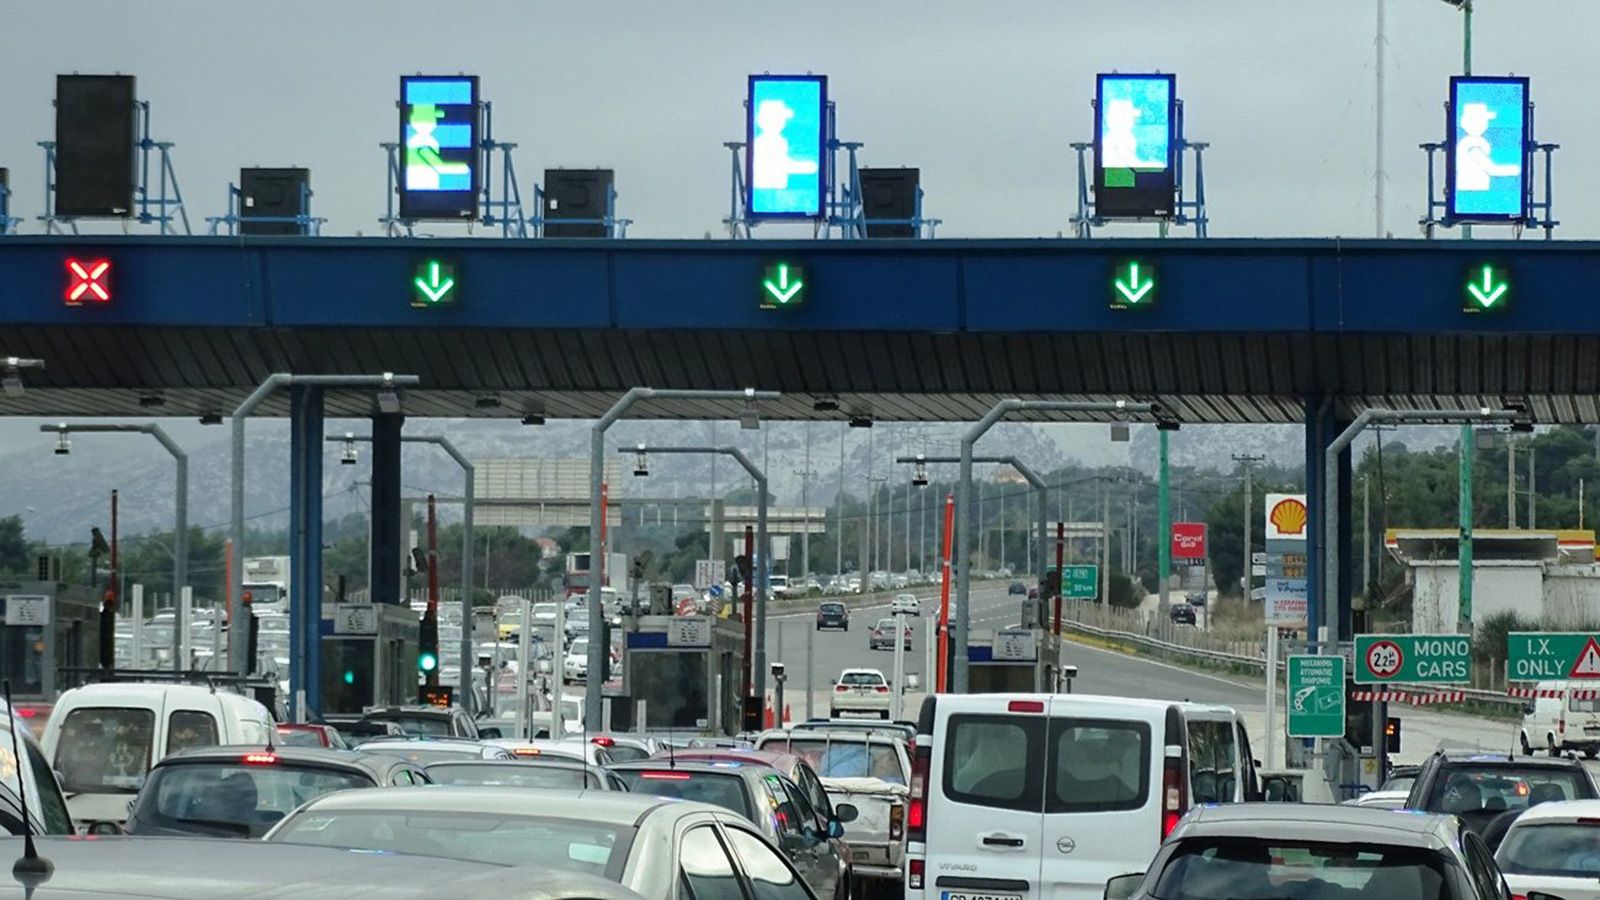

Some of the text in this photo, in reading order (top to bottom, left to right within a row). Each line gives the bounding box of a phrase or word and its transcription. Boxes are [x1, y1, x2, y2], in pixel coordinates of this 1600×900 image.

[1174, 533, 1203, 542] Coral
[1416, 661, 1466, 677] CARS
[1517, 659, 1565, 676] ONLY
